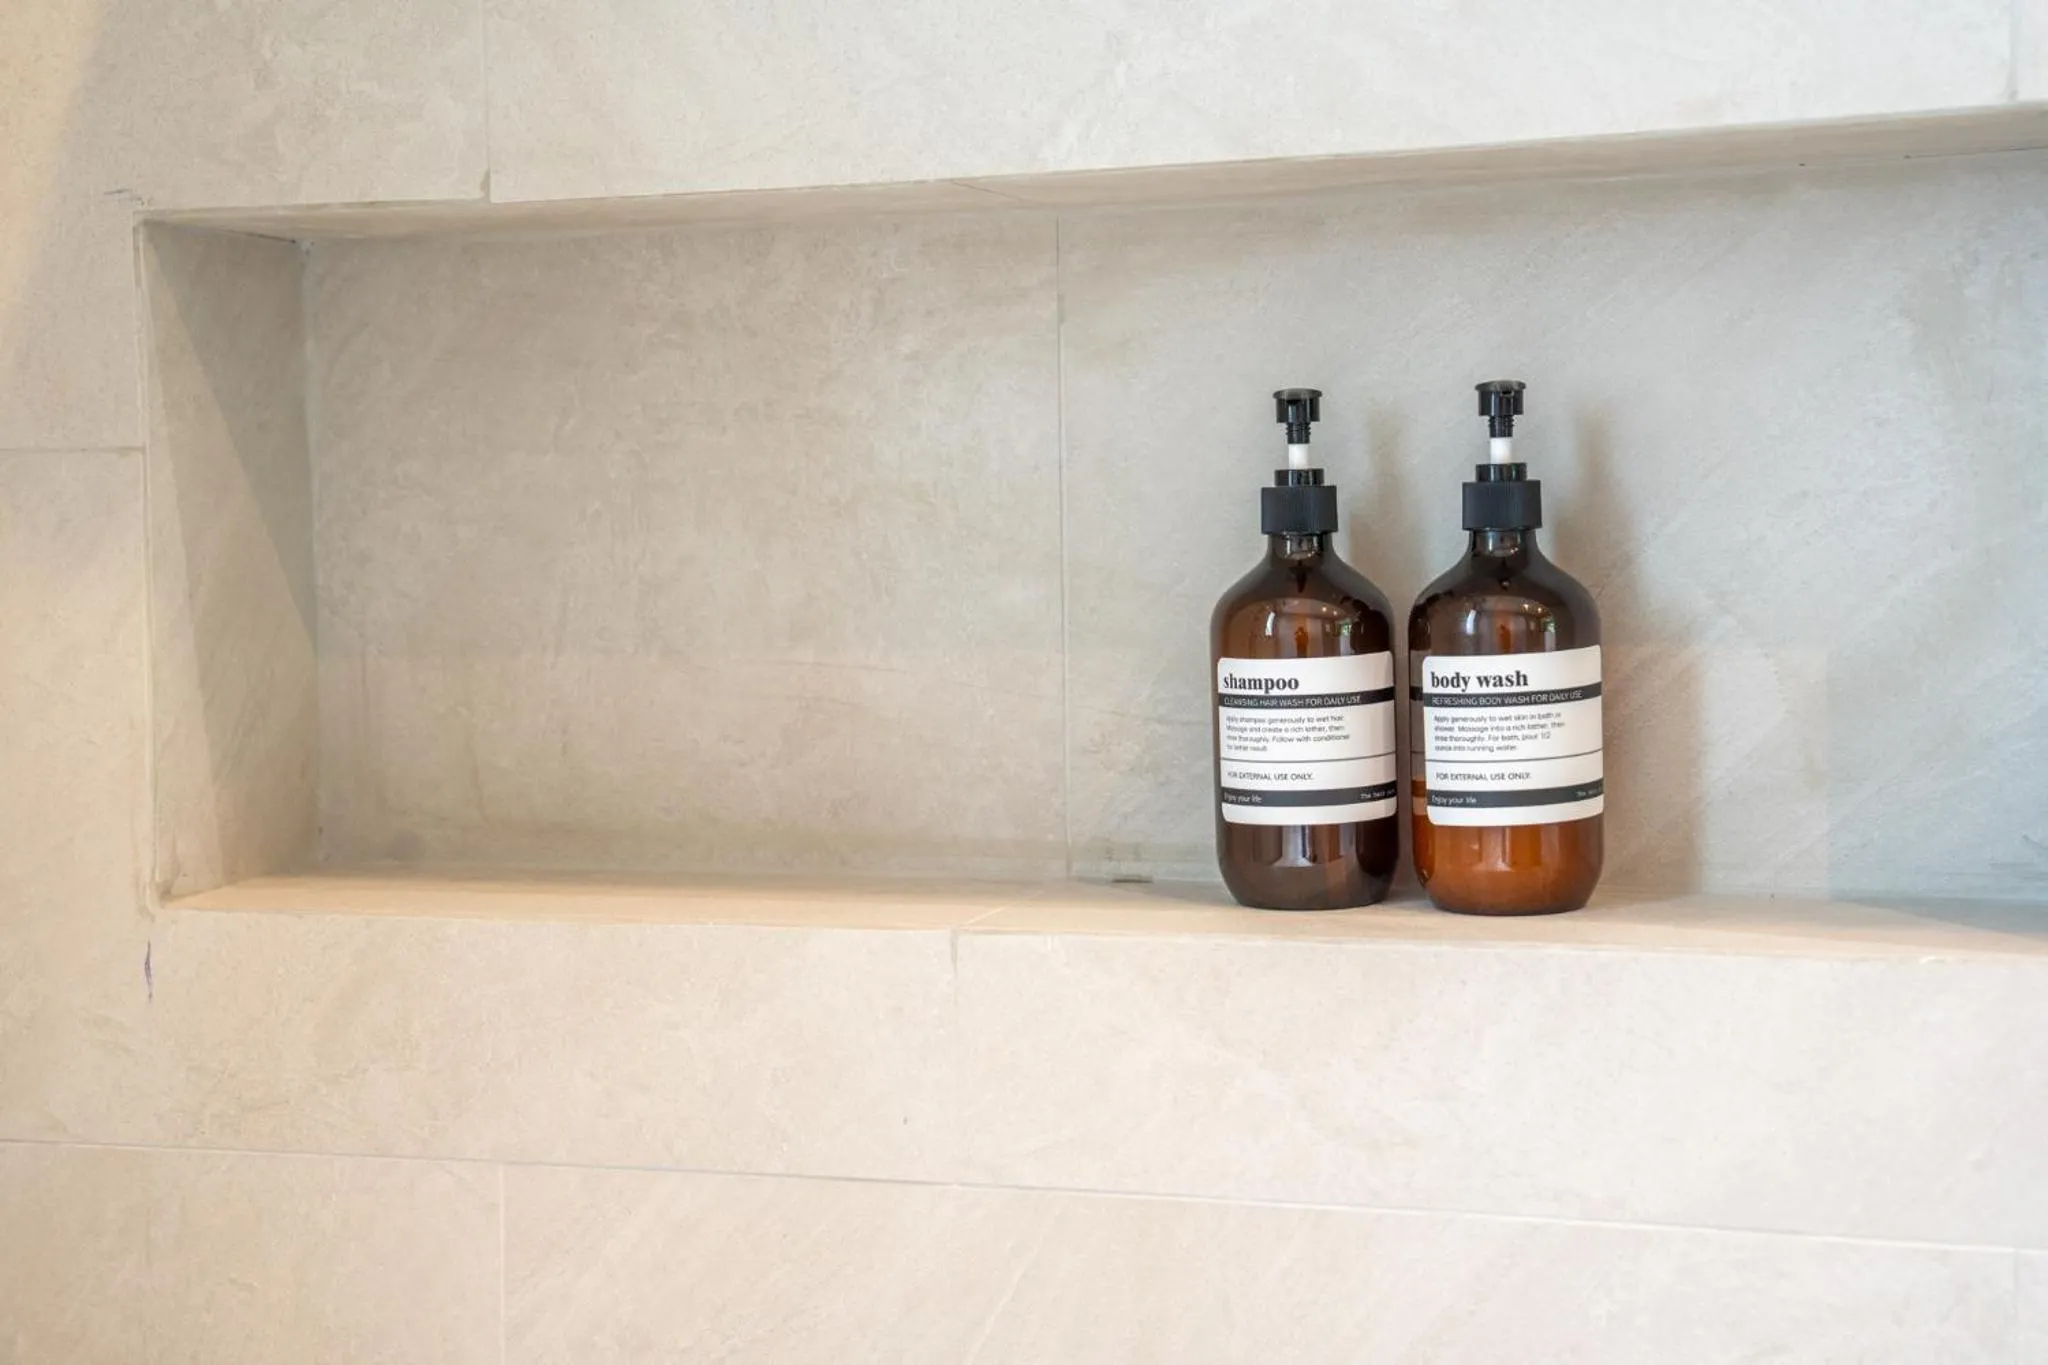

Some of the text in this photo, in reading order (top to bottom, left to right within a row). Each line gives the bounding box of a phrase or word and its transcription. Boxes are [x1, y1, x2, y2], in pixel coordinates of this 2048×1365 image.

[1224, 673, 1299, 694] shampoo
[1431, 670, 1528, 692] body wash
[1224, 695, 1361, 707] CLEANSING HAIR WASH FOR DAILY USE
[1432, 690, 1584, 706] REFRESHING BODY WASH FOR DAILY USE
[1268, 716, 1305, 725] generously
[1451, 715, 1488, 724] generously
[1514, 713, 1528, 721] skin
[1458, 725, 1489, 733] Massage
[1272, 735, 1294, 743] Follow
[1295, 735, 1311, 743] with
[1488, 734, 1499, 742] For
[1467, 745, 1495, 753] running
[1239, 772, 1272, 780] EXTERNAL
[1274, 773, 1288, 781] USE
[1436, 772, 1449, 780] FOR
[1450, 773, 1488, 781] EXTERNAL
[1490, 773, 1507, 781] USE
[1431, 795, 1447, 805] Enjoy
[1447, 796, 1463, 806] your
[1465, 796, 1477, 804] life
